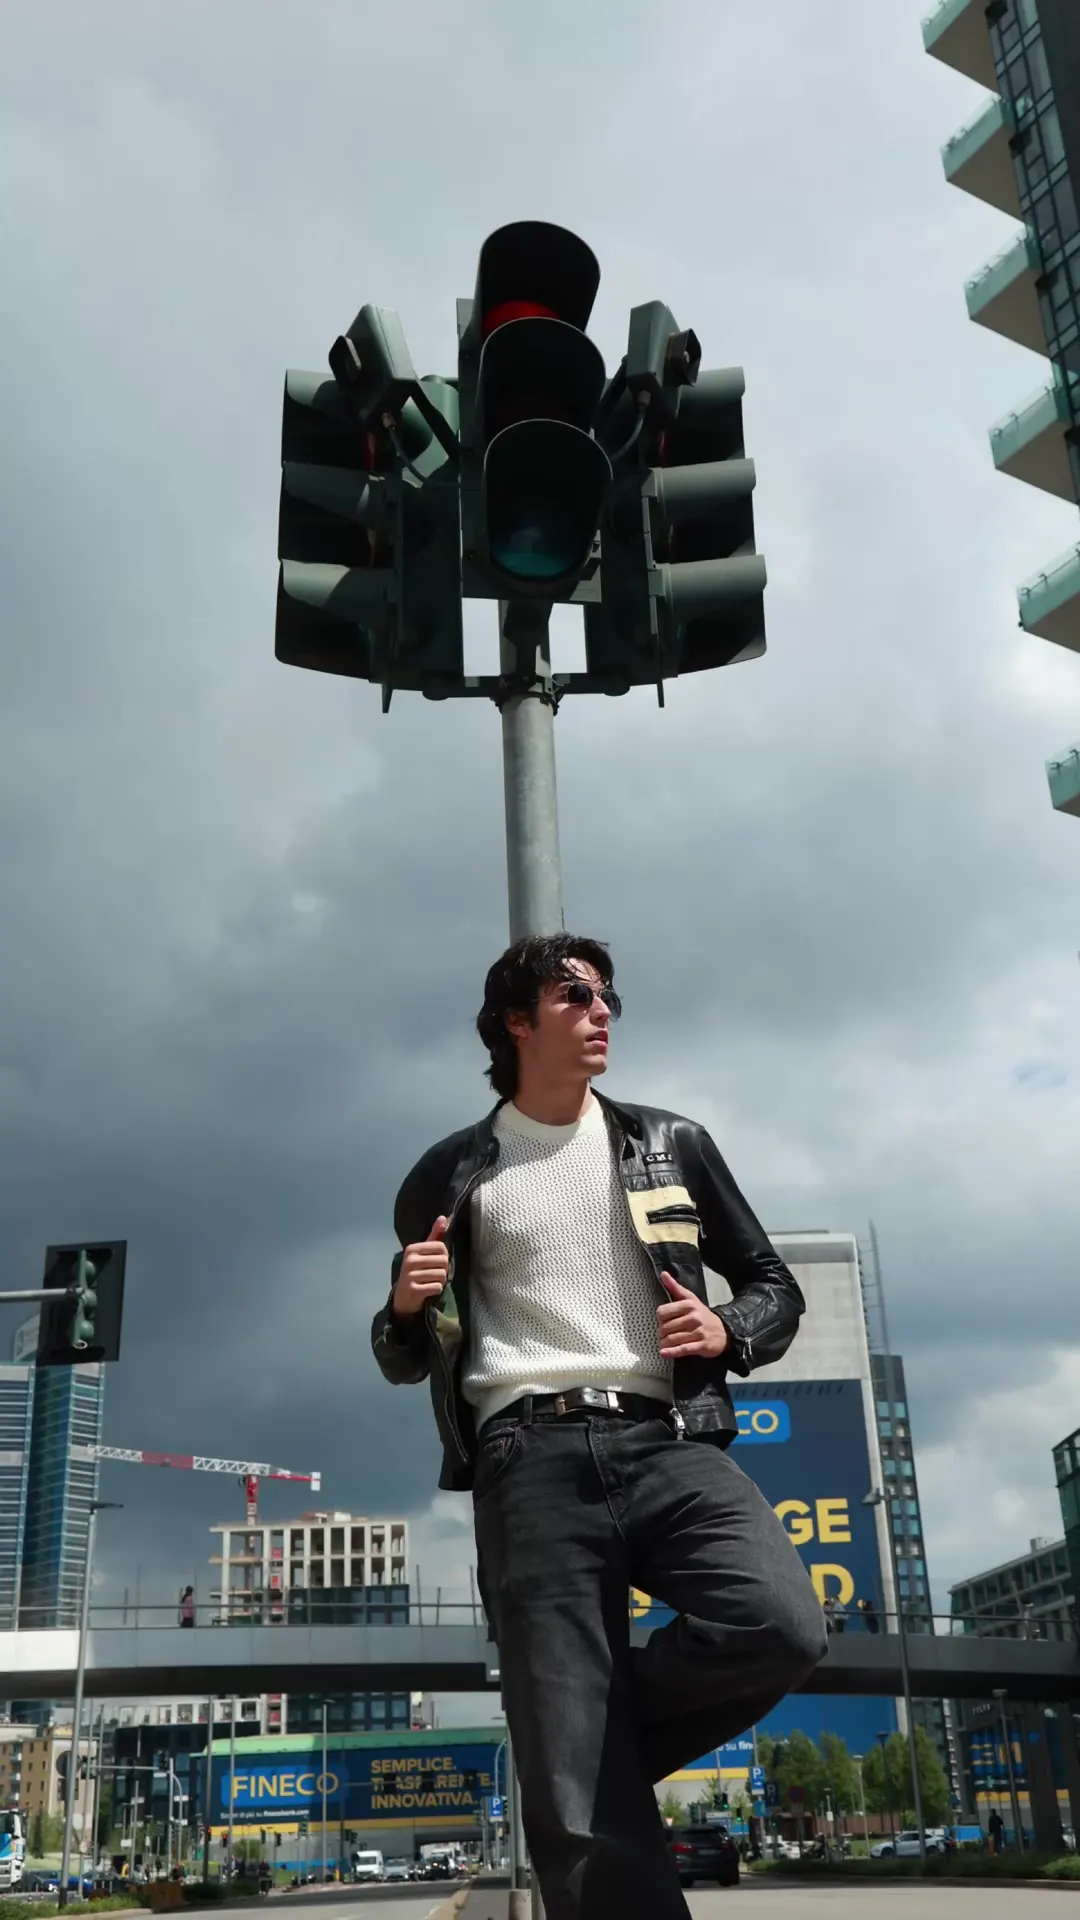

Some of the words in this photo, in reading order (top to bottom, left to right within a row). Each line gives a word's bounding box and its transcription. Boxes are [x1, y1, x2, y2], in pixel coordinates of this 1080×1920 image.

[735, 1408, 779, 1435] CO
[773, 1498, 852, 1545] GE
[371, 1757, 457, 1773] SEMPLICE.
[753, 1767, 761, 1779] P
[232, 1771, 339, 1799] FINECO
[371, 1791, 478, 1809] INNOVATIVA.
[492, 1797, 501, 1808] P
